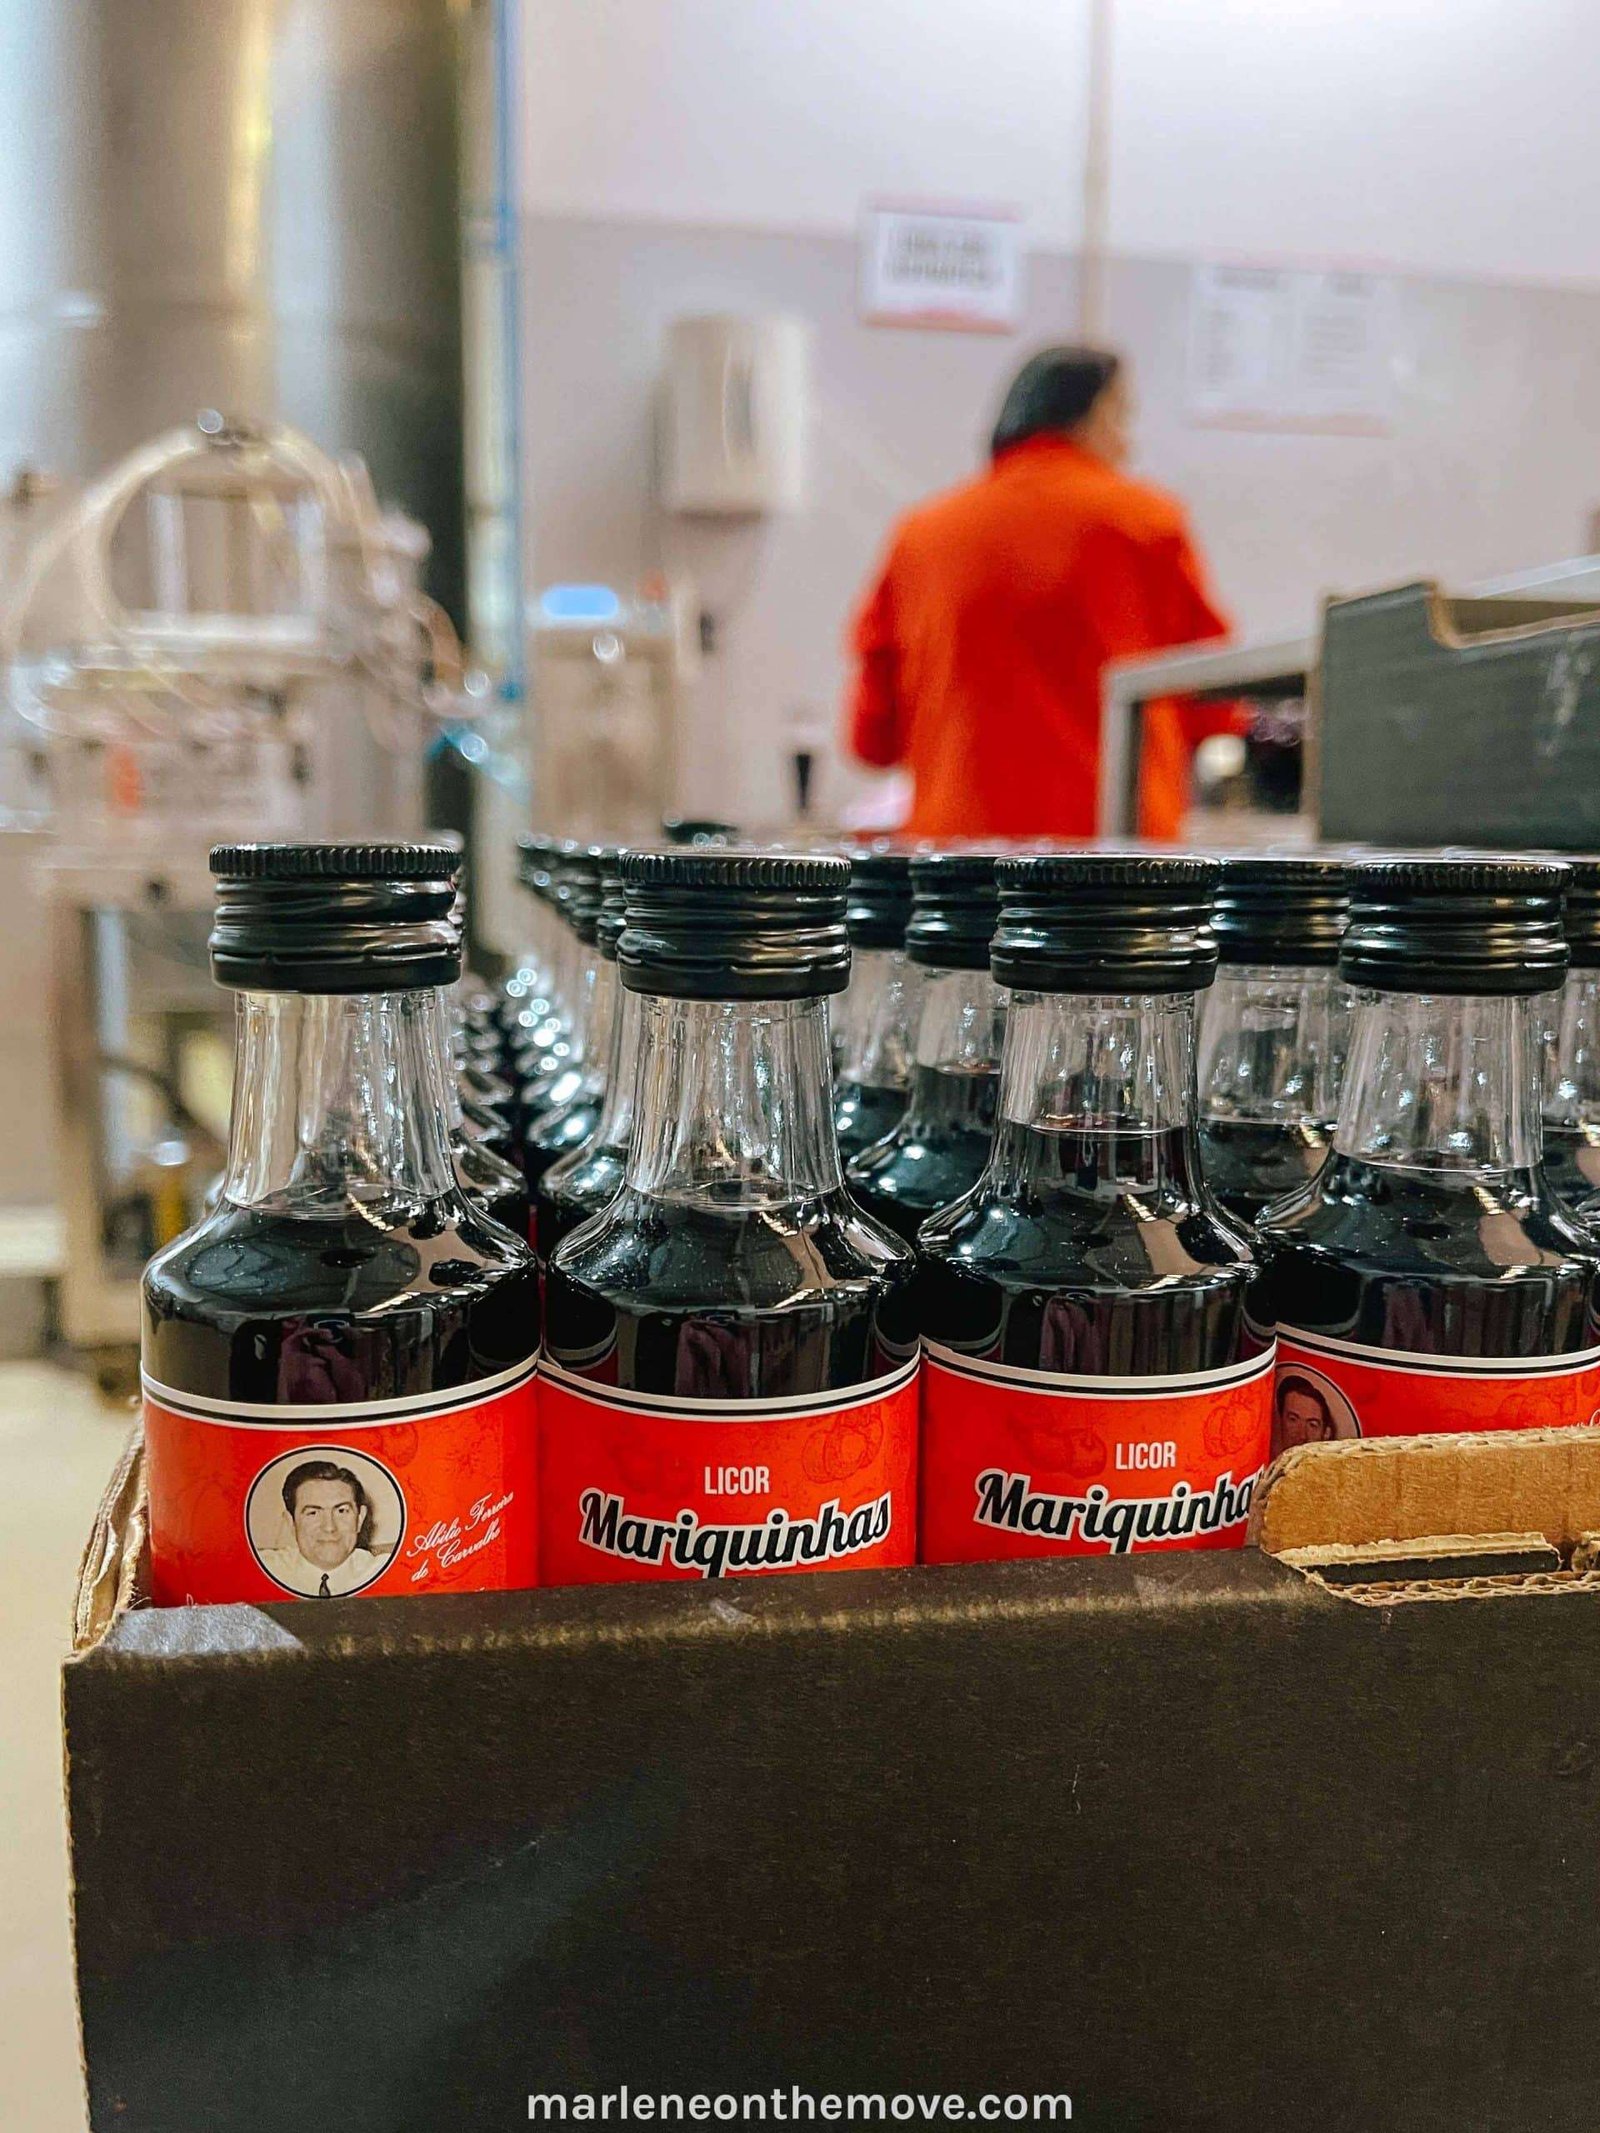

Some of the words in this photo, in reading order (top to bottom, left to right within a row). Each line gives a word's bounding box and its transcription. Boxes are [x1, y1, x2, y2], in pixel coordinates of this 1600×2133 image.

[1115, 1441, 1177, 1471] LICOR
[704, 1466, 770, 1495] LICOR
[974, 1467, 1258, 1555] Mariquinha
[578, 1487, 892, 1579] Mariquinhas
[411, 1558, 429, 1582] de
